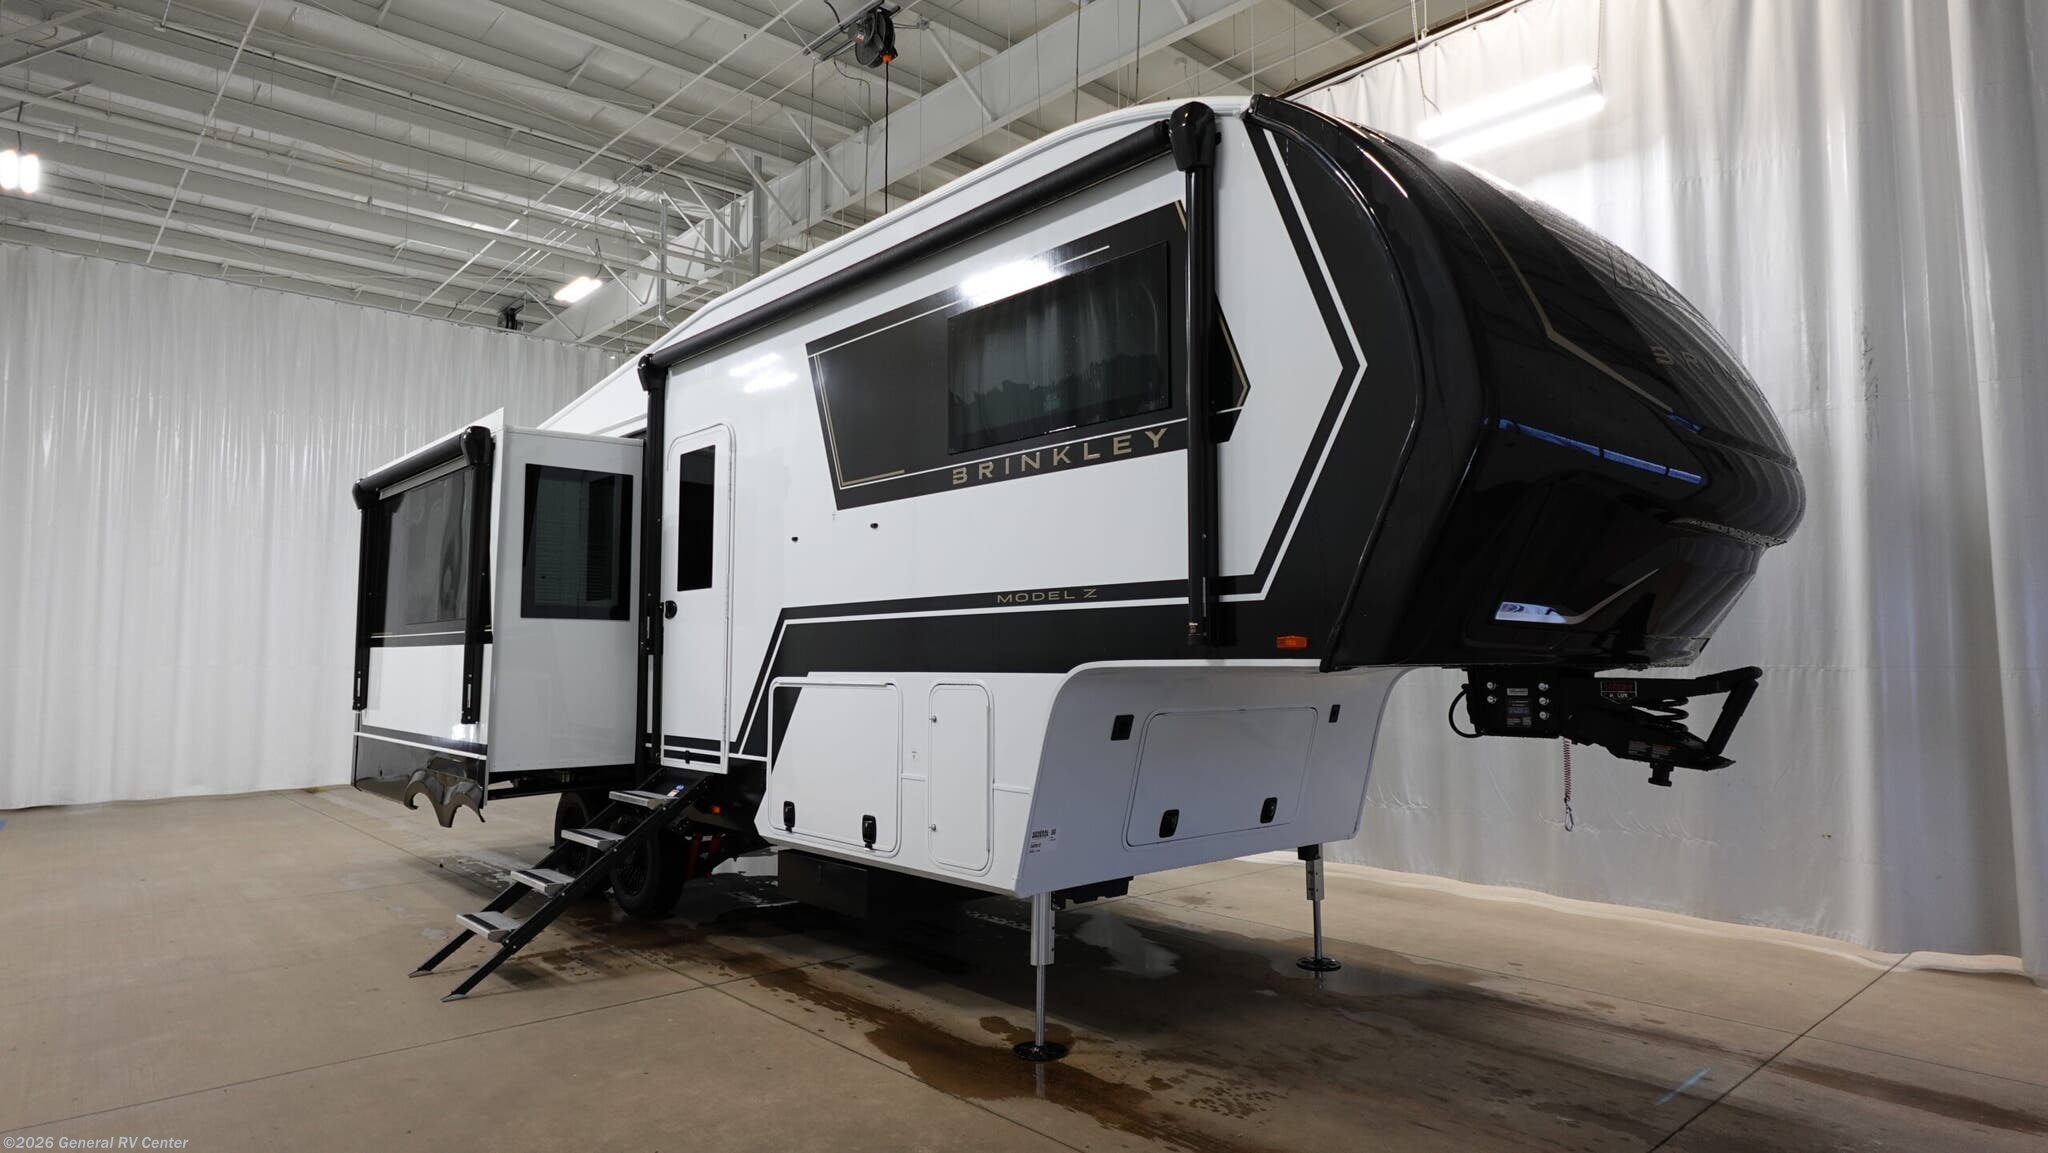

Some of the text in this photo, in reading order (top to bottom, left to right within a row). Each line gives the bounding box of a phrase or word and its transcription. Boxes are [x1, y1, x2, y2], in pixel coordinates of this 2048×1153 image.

[952, 428, 1168, 485] BRINKLEY
[997, 588, 1097, 604] MODEL Z
